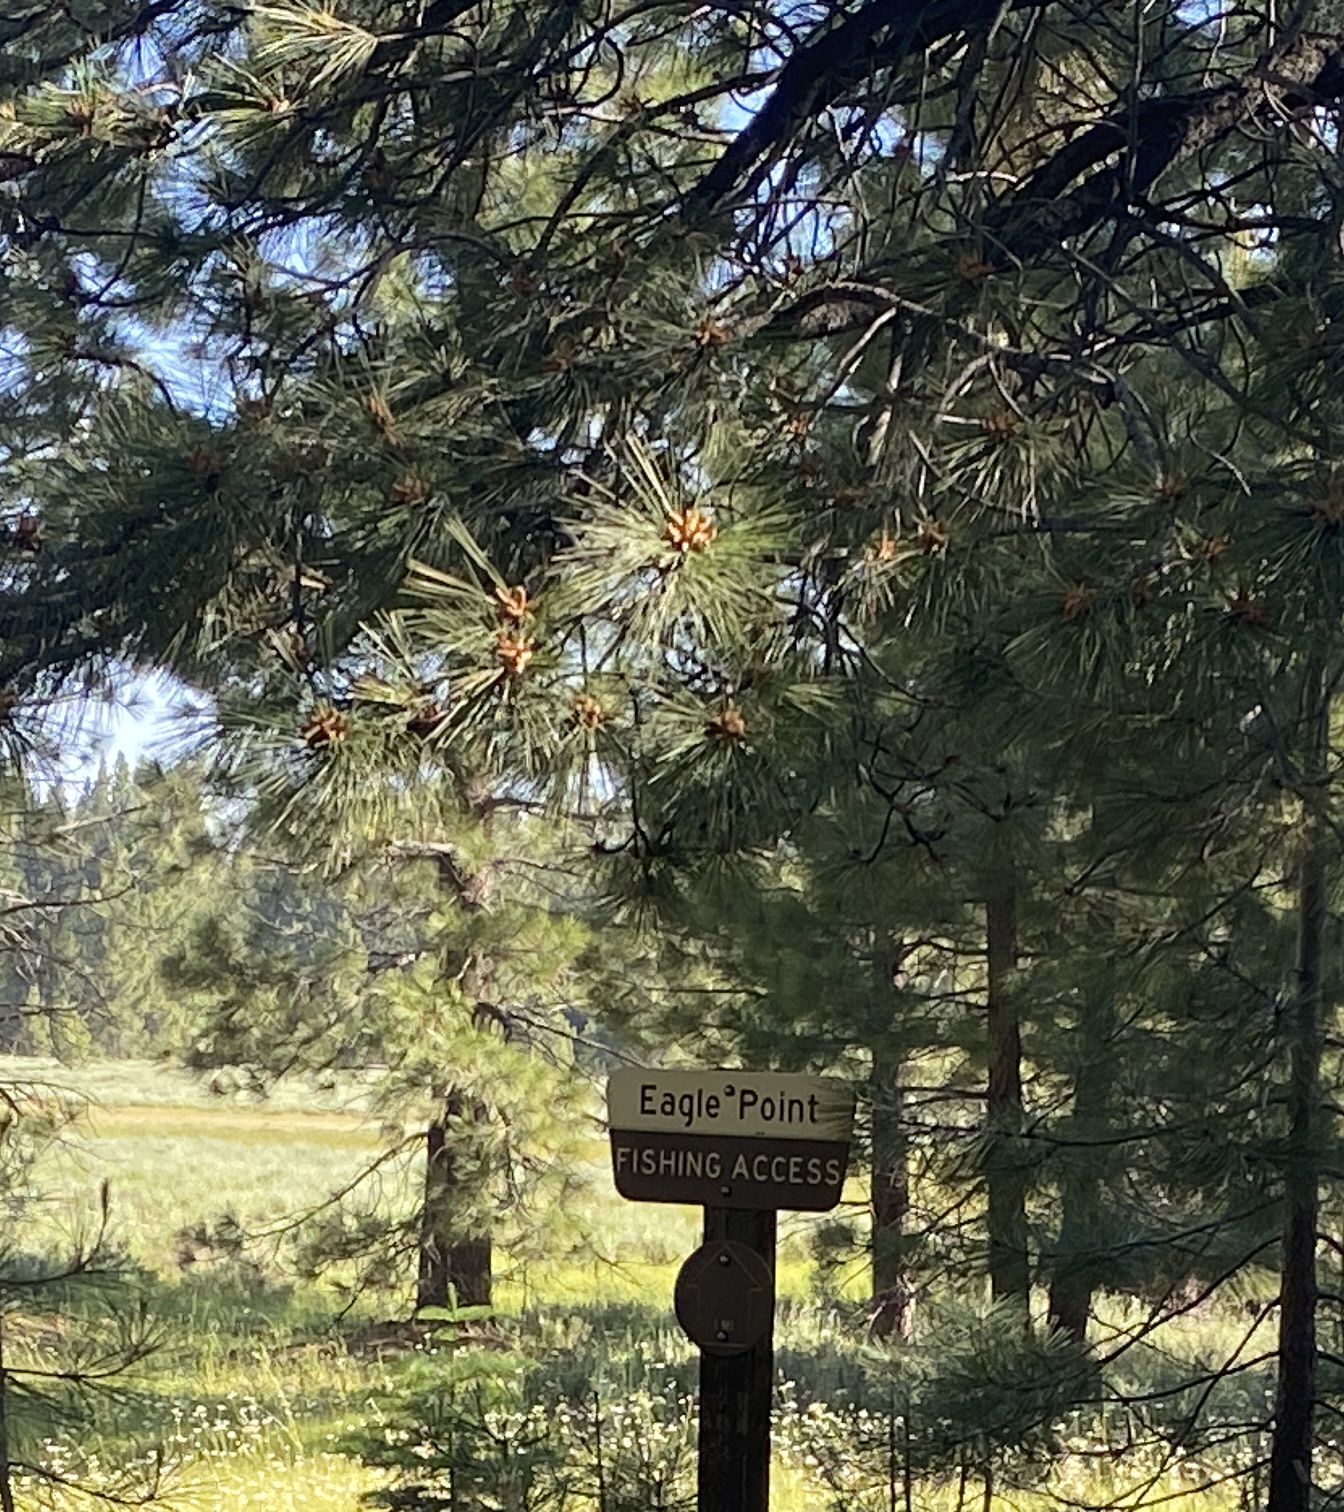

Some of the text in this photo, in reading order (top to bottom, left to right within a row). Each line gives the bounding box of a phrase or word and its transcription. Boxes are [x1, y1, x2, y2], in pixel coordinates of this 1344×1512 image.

[640, 1084, 819, 1127] Eagle Point
[616, 1147, 840, 1185] FISHING ACCESS
